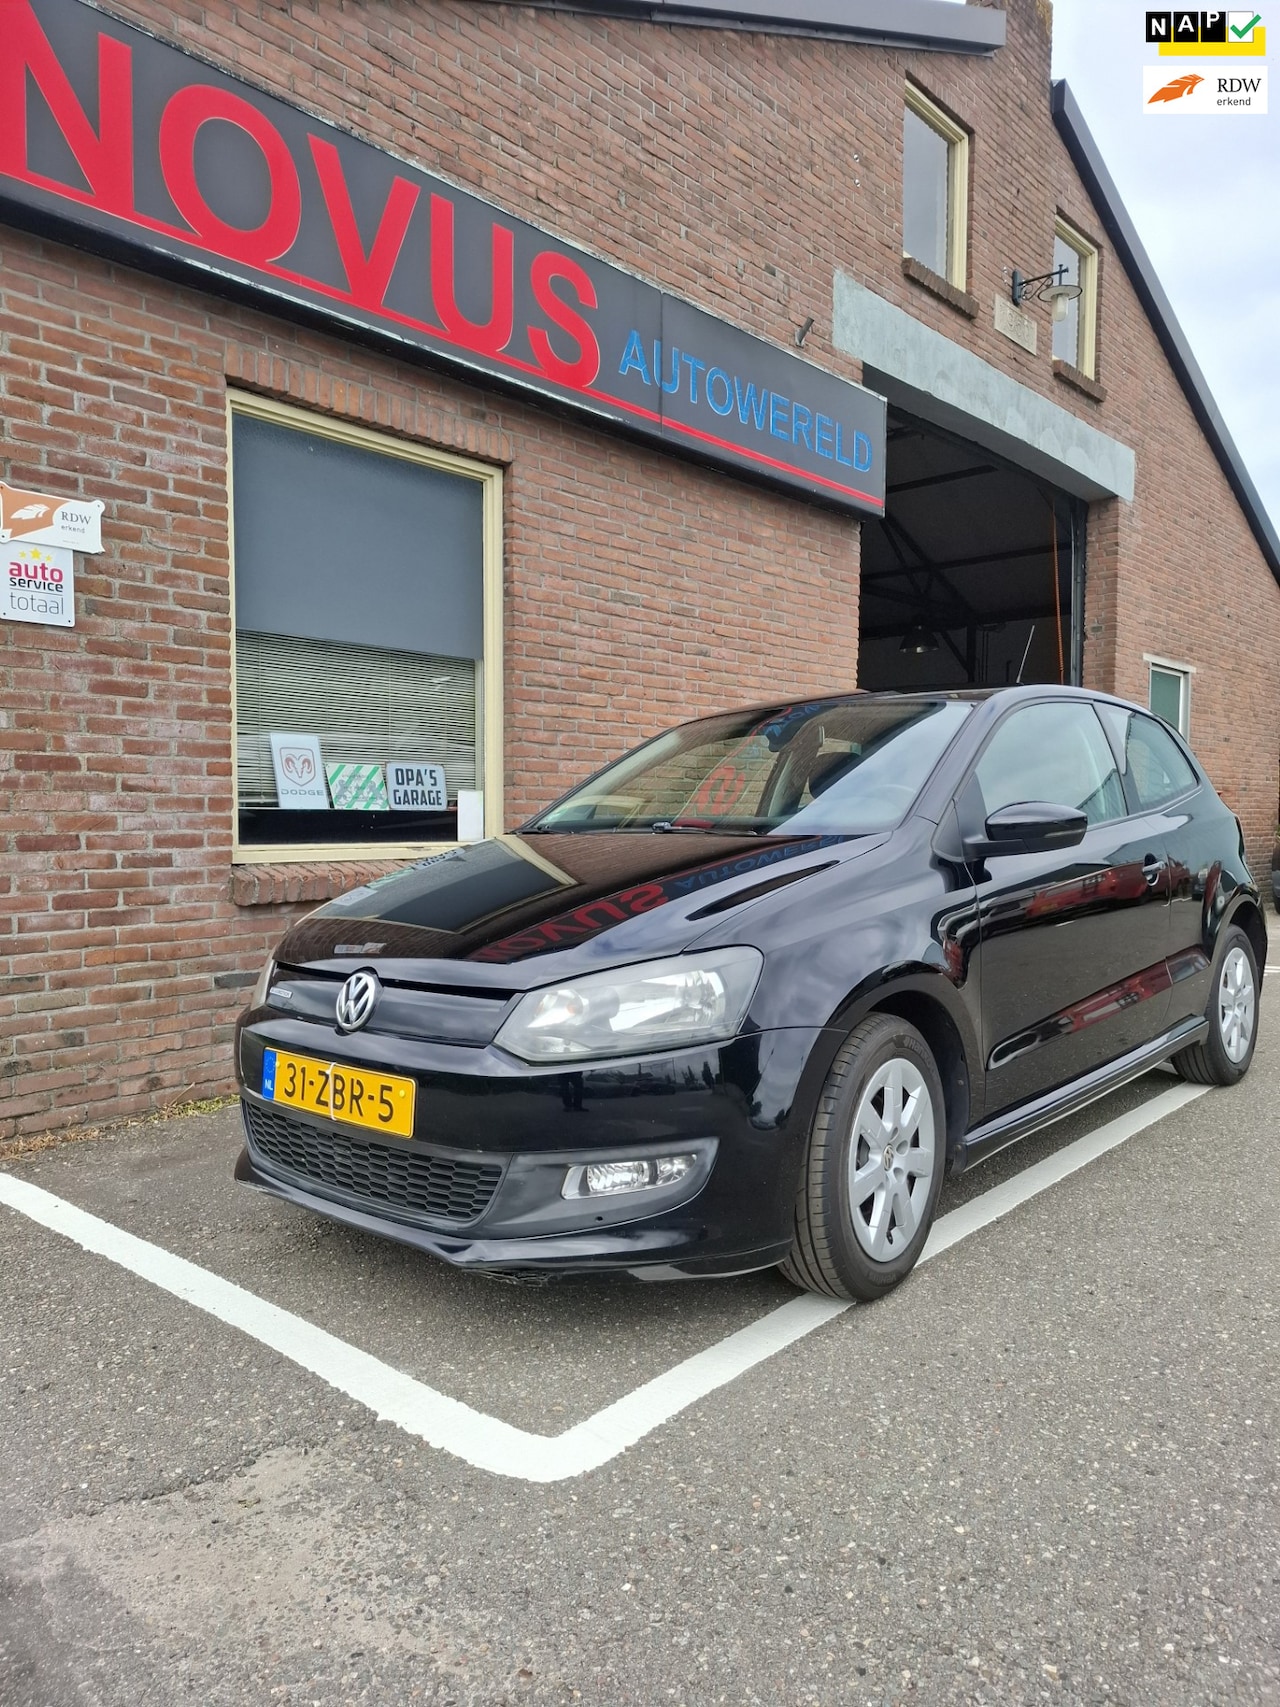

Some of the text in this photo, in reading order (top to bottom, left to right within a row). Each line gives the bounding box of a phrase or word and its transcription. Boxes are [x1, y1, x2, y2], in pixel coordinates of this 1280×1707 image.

[0, 0, 873, 473] NOVUS AUTOWERELD
[61, 511, 92, 525] RDW
[61, 525, 85, 534] erkend
[9, 562, 63, 583] auto
[10, 577, 63, 592] service
[10, 592, 64, 615] totaal
[395, 768, 438, 787] OPA'S
[281, 788, 324, 797] DODGE
[393, 789, 442, 806] GARAGE
[264, 1079, 273, 1091] NL
[284, 1063, 394, 1123] 31-ZBR-5
